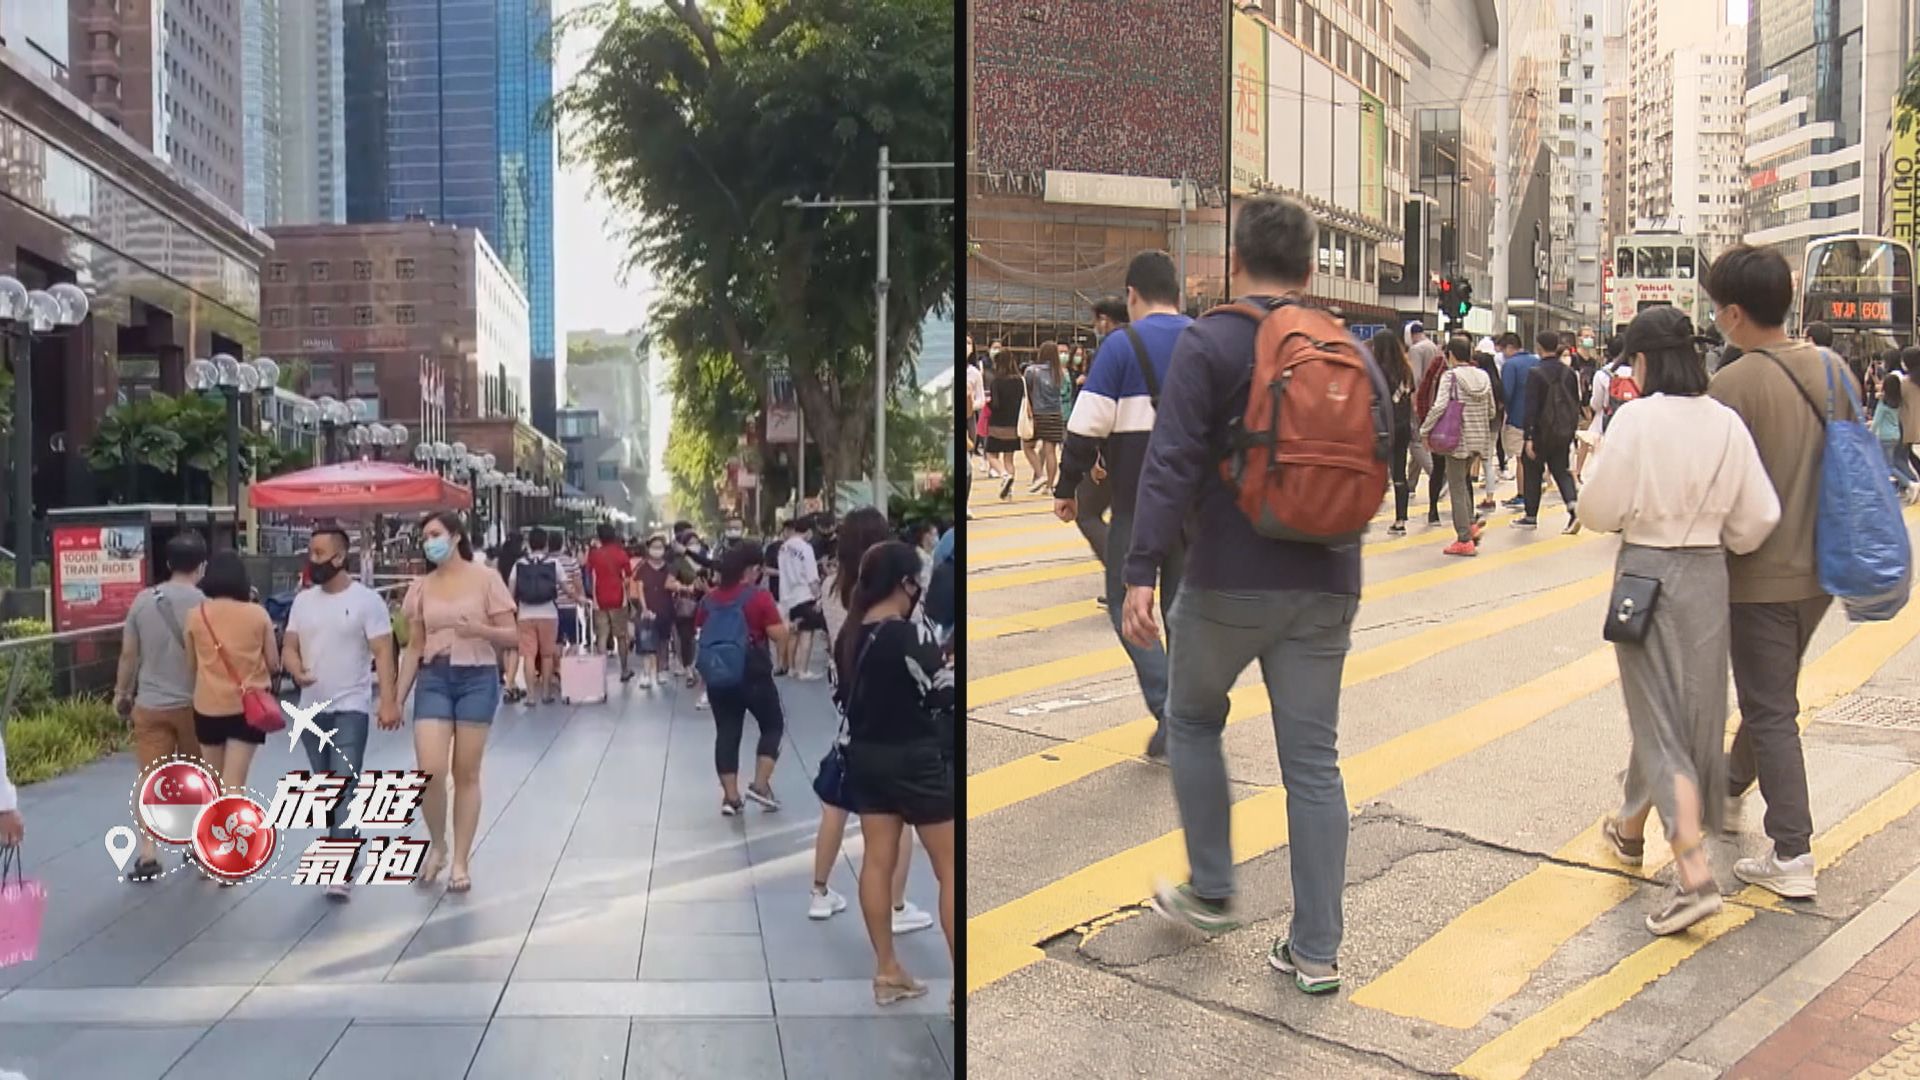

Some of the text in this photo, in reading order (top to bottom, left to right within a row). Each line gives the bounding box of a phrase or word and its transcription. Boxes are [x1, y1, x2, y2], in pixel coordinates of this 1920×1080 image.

[1862, 301, 1889, 320] 601
[64, 562, 135, 576] TRAIN RIDES
